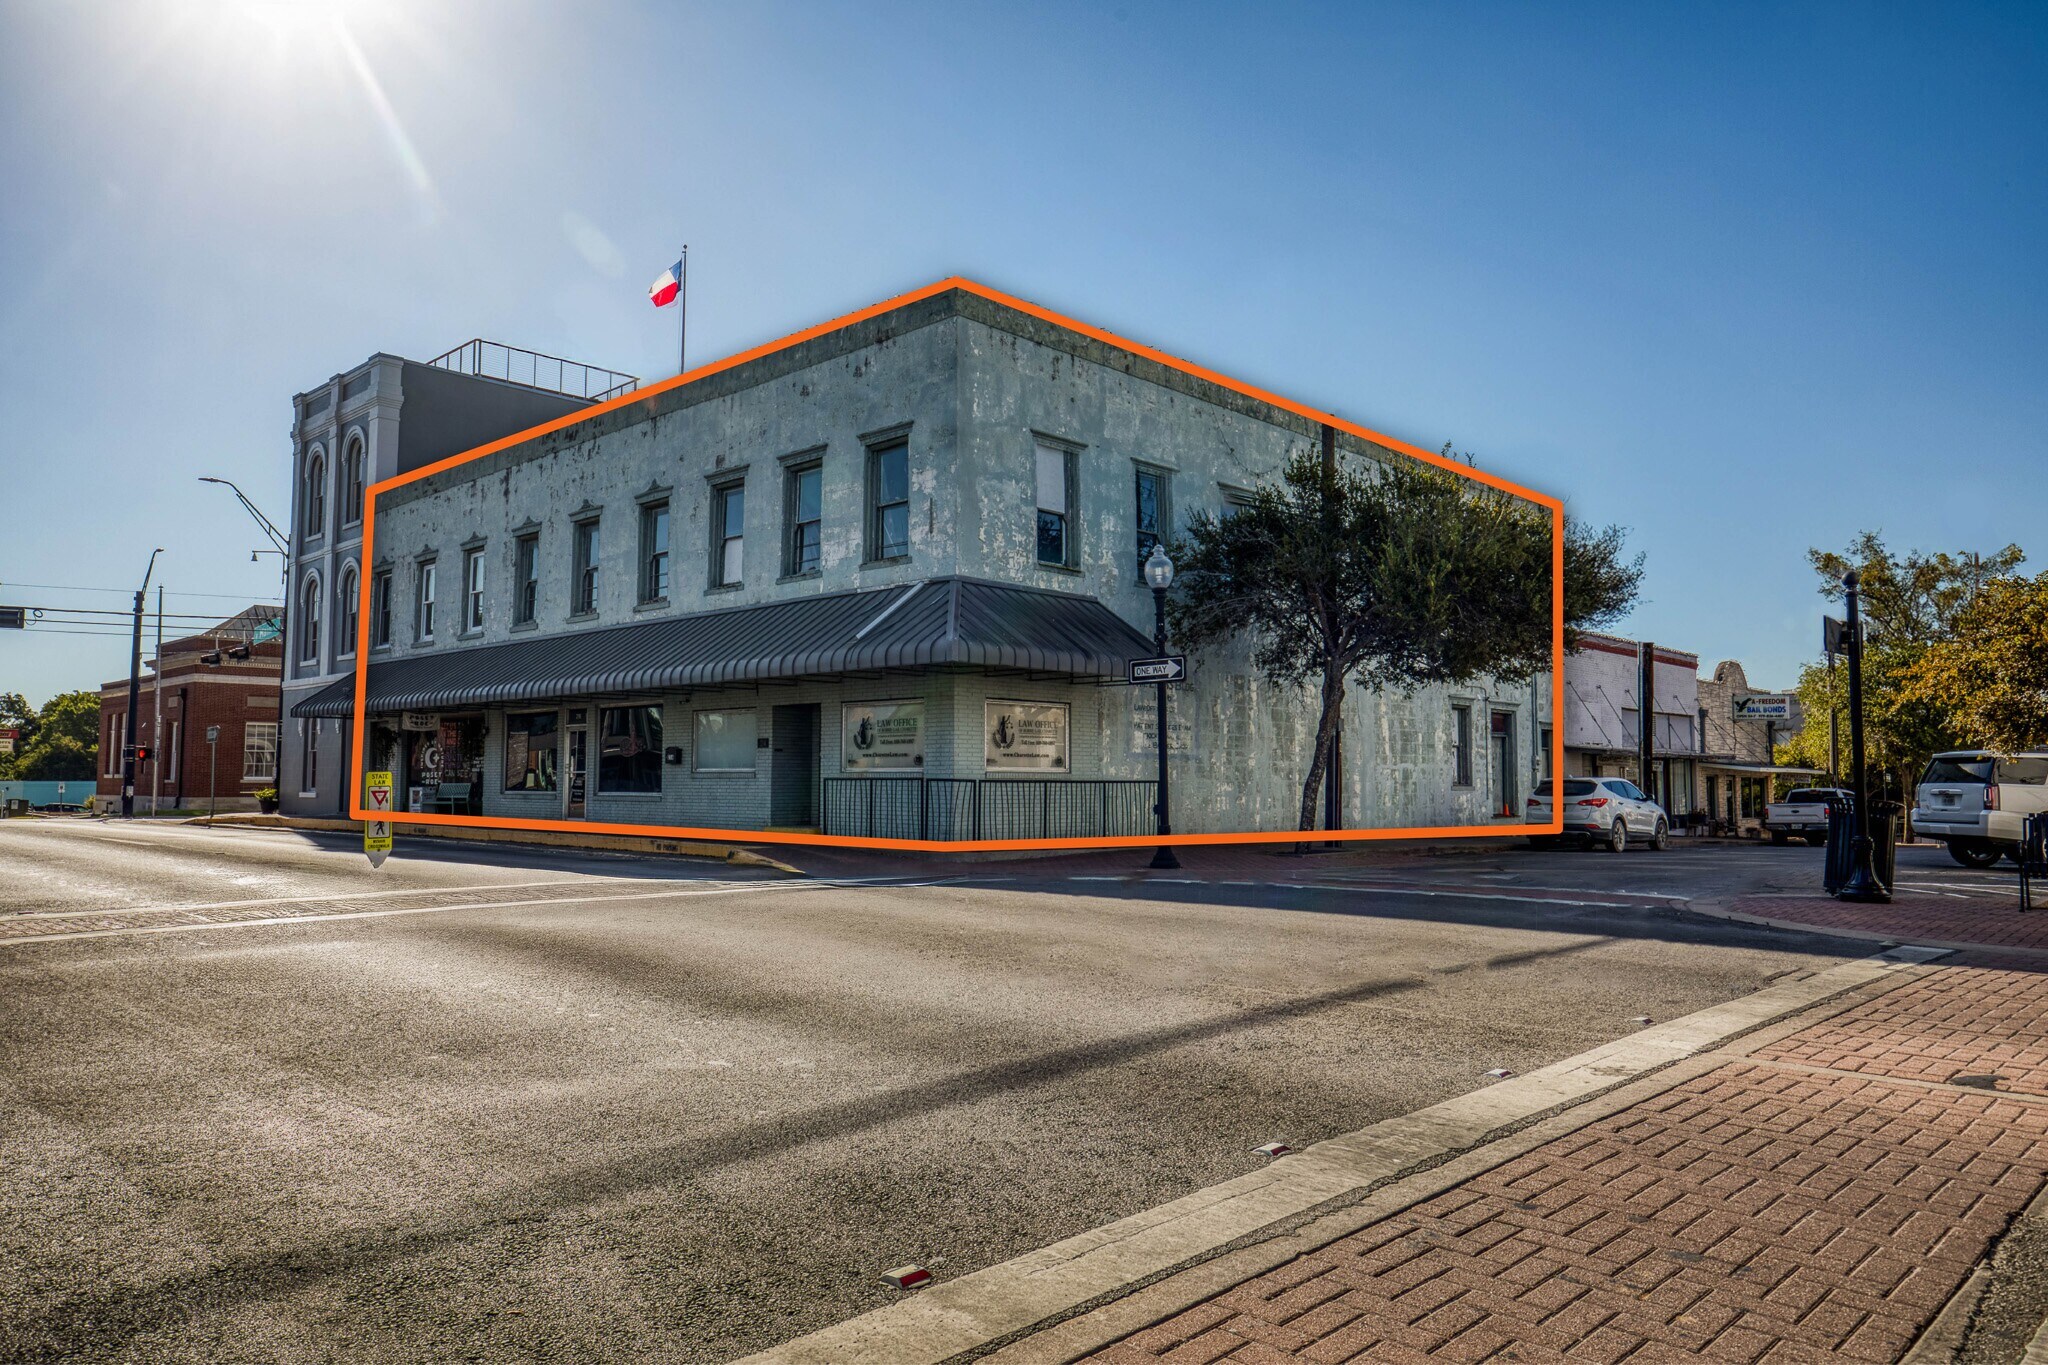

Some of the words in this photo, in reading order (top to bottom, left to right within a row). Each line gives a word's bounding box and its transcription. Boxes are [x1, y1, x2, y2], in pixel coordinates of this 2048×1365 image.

[1136, 667, 1151, 676] ONE
[1152, 665, 1167, 674] WAY
[877, 719, 891, 728] LAW
[893, 718, 917, 728] OFFICE
[1018, 720, 1033, 728] LAW
[1035, 720, 1058, 729] OFFICE
